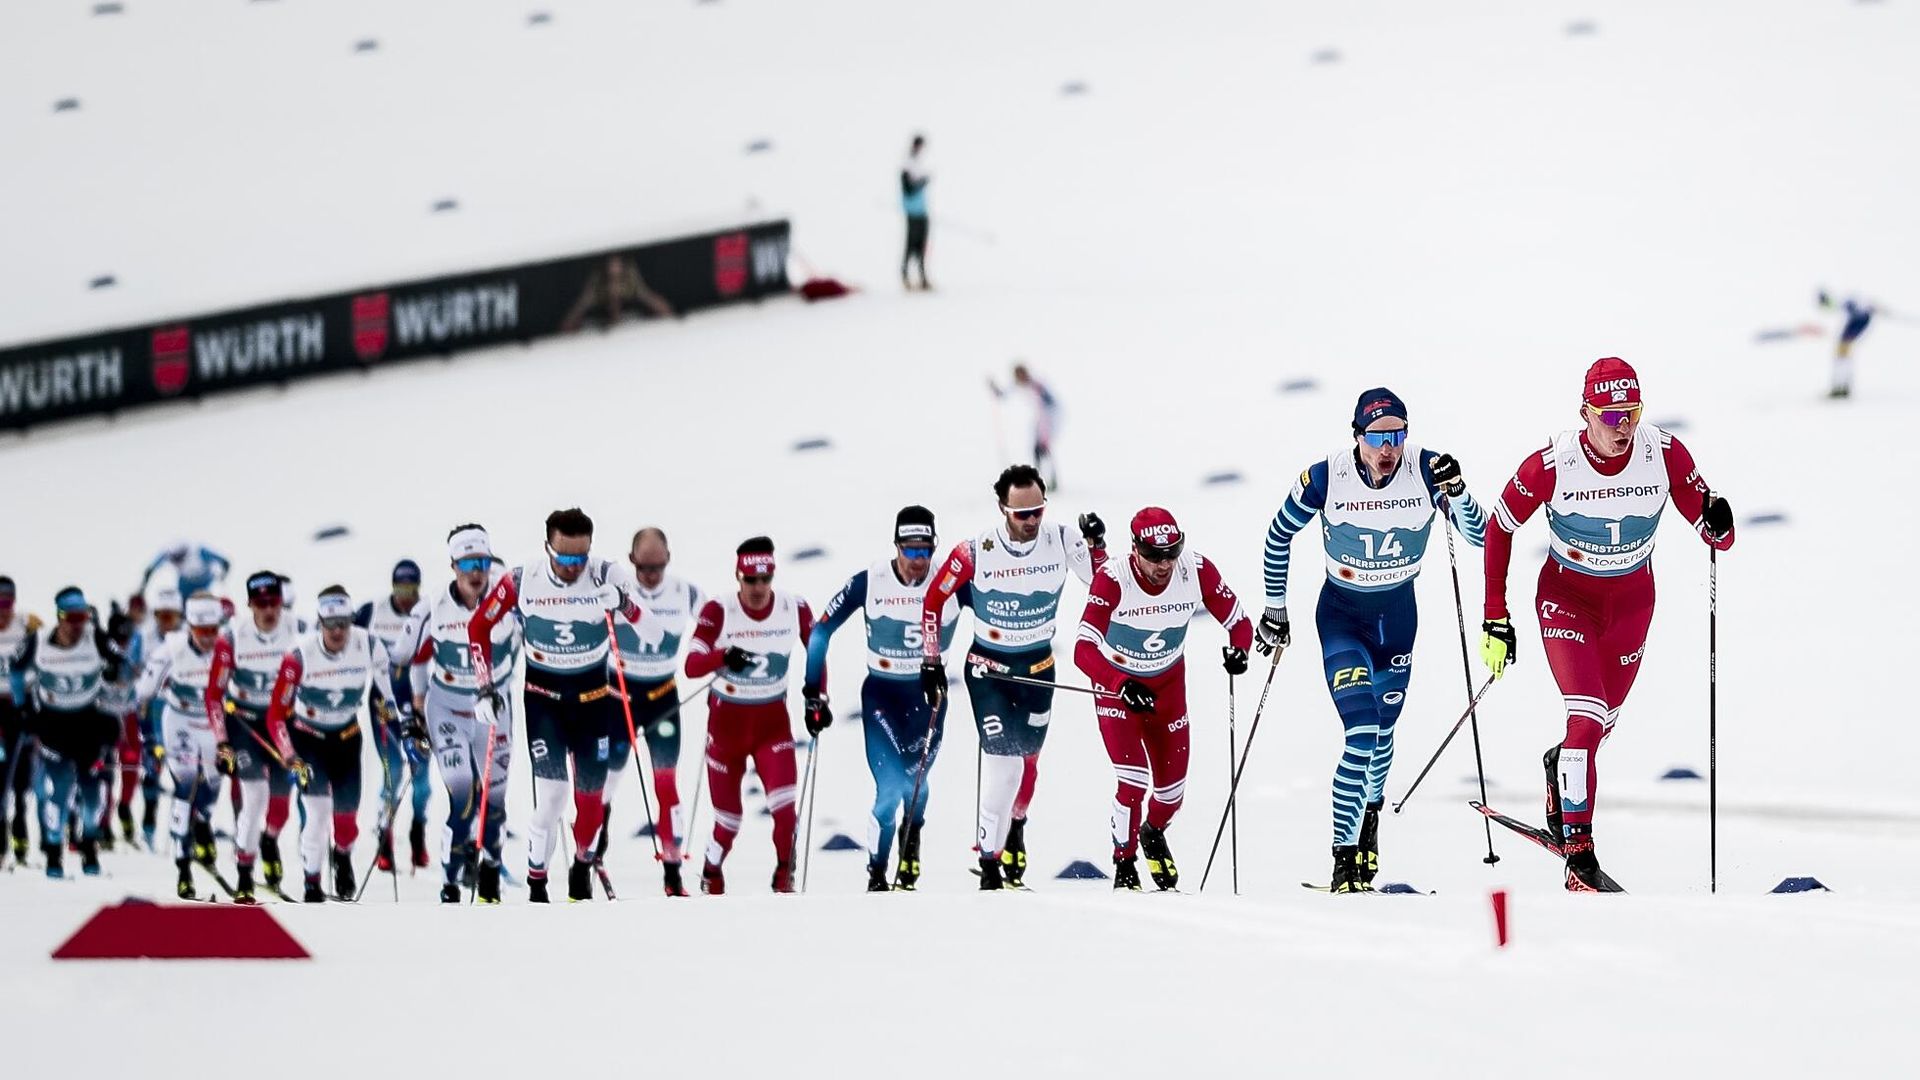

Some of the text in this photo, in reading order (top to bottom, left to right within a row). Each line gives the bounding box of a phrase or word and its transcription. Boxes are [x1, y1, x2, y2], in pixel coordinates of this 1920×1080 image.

[1594, 379, 1639, 394] LUKOIL
[1575, 485, 1660, 501] INTERSPORT
[1346, 497, 1423, 512] INTERSPORT
[1604, 522, 1621, 545] 1
[1359, 532, 1403, 560] 14
[1568, 538, 1642, 553] OBERSTDORF
[1341, 553, 1411, 569] OBERSTDORF
[993, 563, 1060, 579] INTERSPORT
[1128, 602, 1195, 618] INTERSPORT
[989, 616, 1047, 629] OBERSTDORF
[553, 624, 576, 646] 3
[902, 624, 924, 649] 5
[1142, 632, 1167, 653] 6
[1543, 627, 1585, 644] LUKOIL
[749, 655, 769, 678] 2
